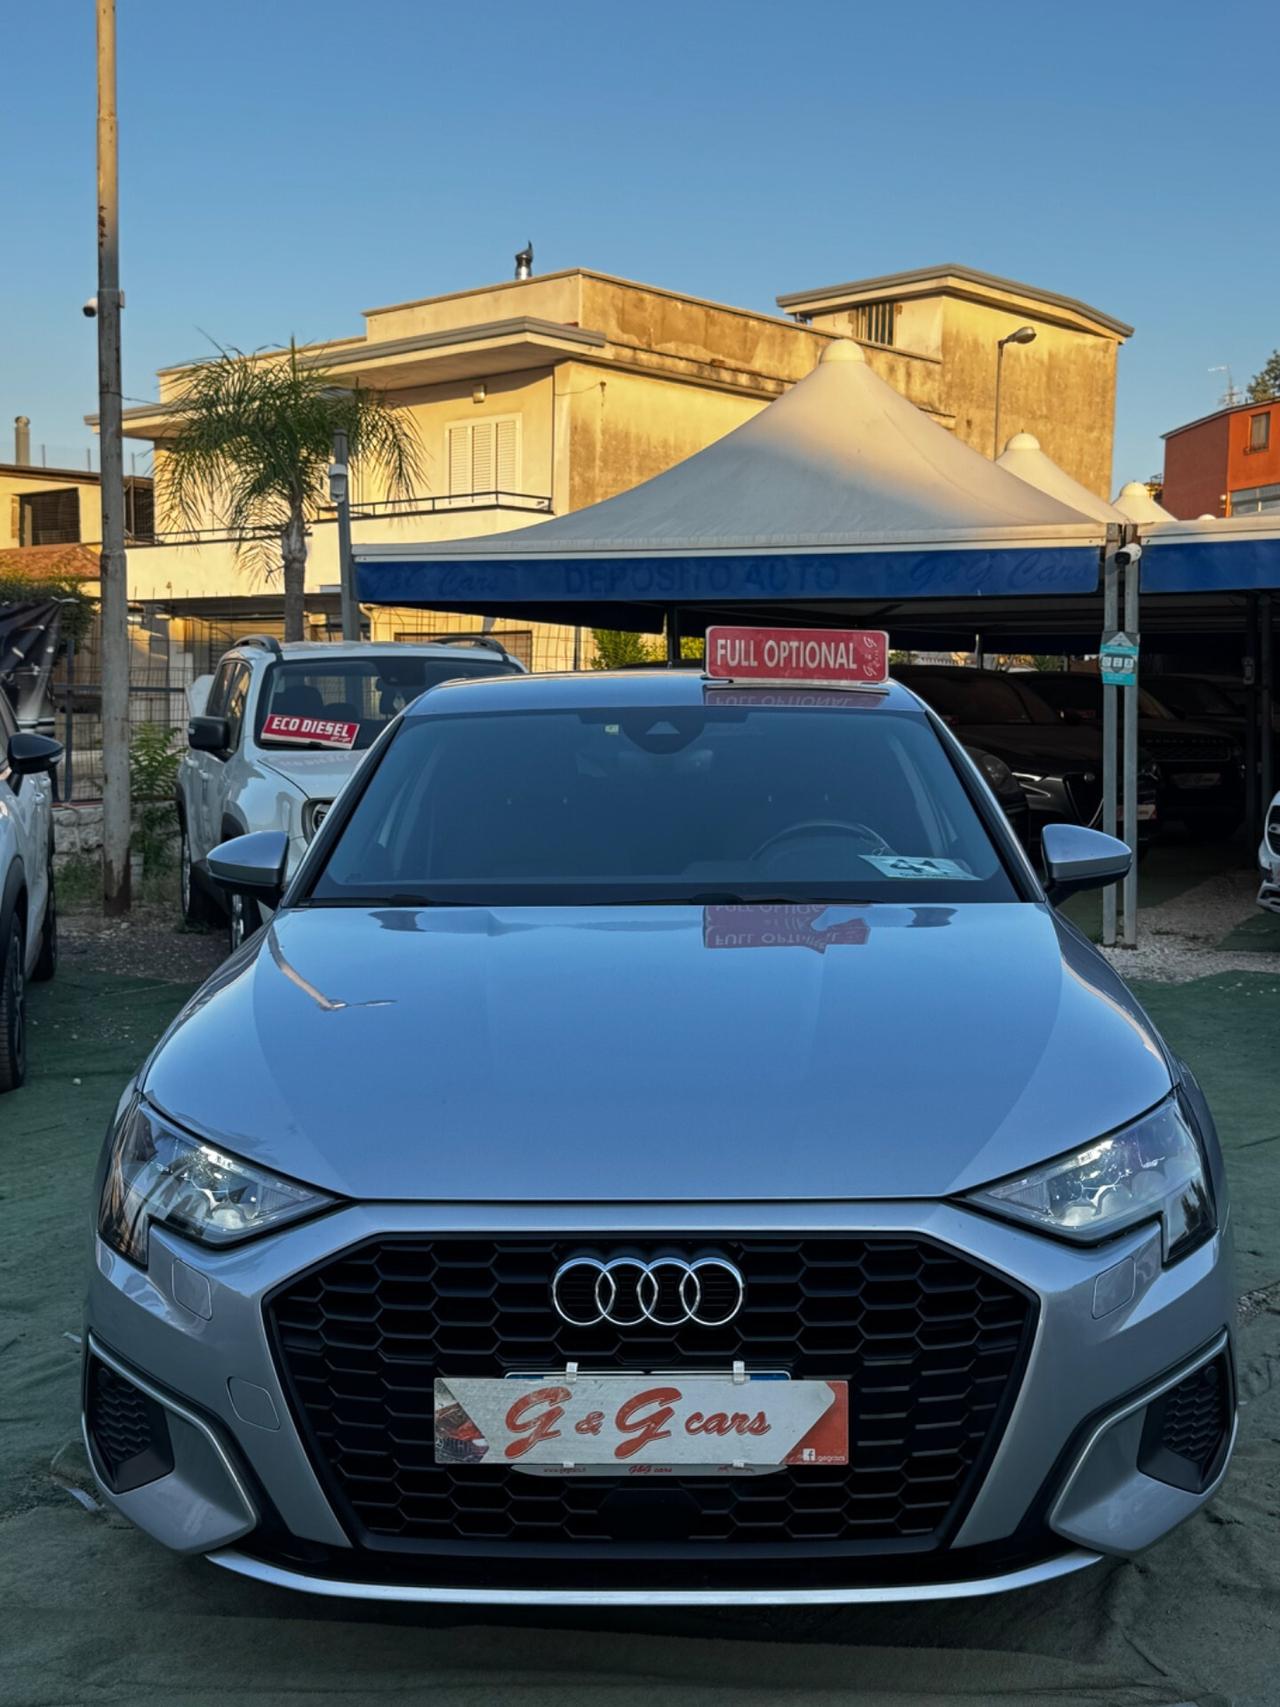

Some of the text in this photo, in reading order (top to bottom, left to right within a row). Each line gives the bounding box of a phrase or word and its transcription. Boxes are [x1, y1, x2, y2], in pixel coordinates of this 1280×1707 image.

[564, 562, 732, 595] DEPOSITO
[744, 561, 840, 594] AUTO
[716, 638, 758, 667] FULL
[763, 639, 858, 670] OPTIONAL
[271, 717, 349, 737] ECO DIESEL
[504, 1386, 771, 1459] G & G cars
